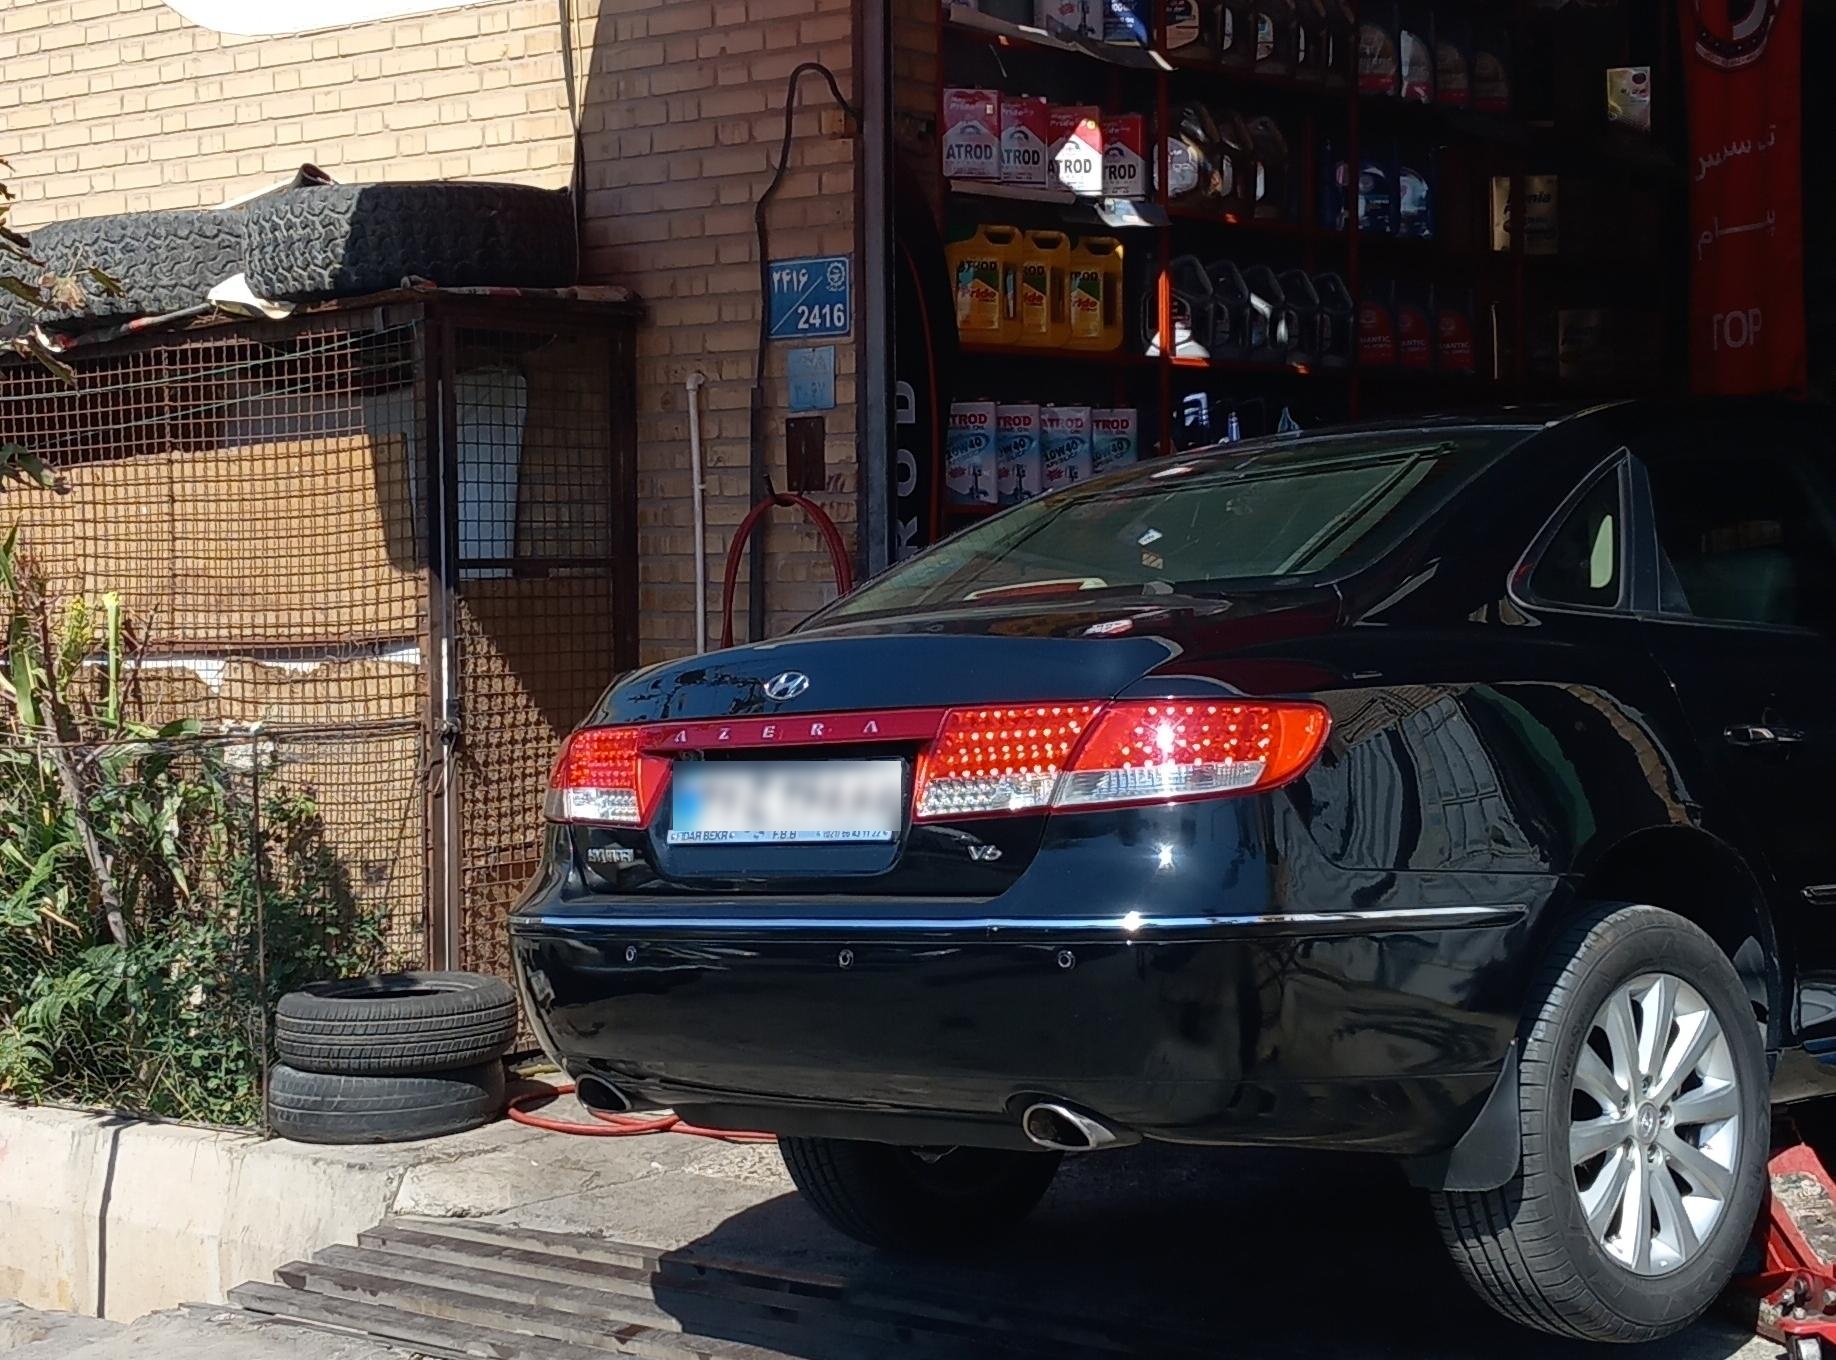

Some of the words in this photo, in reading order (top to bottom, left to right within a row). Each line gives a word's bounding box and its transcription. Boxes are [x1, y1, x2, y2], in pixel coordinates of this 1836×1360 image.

[946, 143, 993, 160] ATROD
[796, 303, 845, 329] 2416
[673, 719, 880, 744] AZERA
[967, 843, 1003, 863] V6
